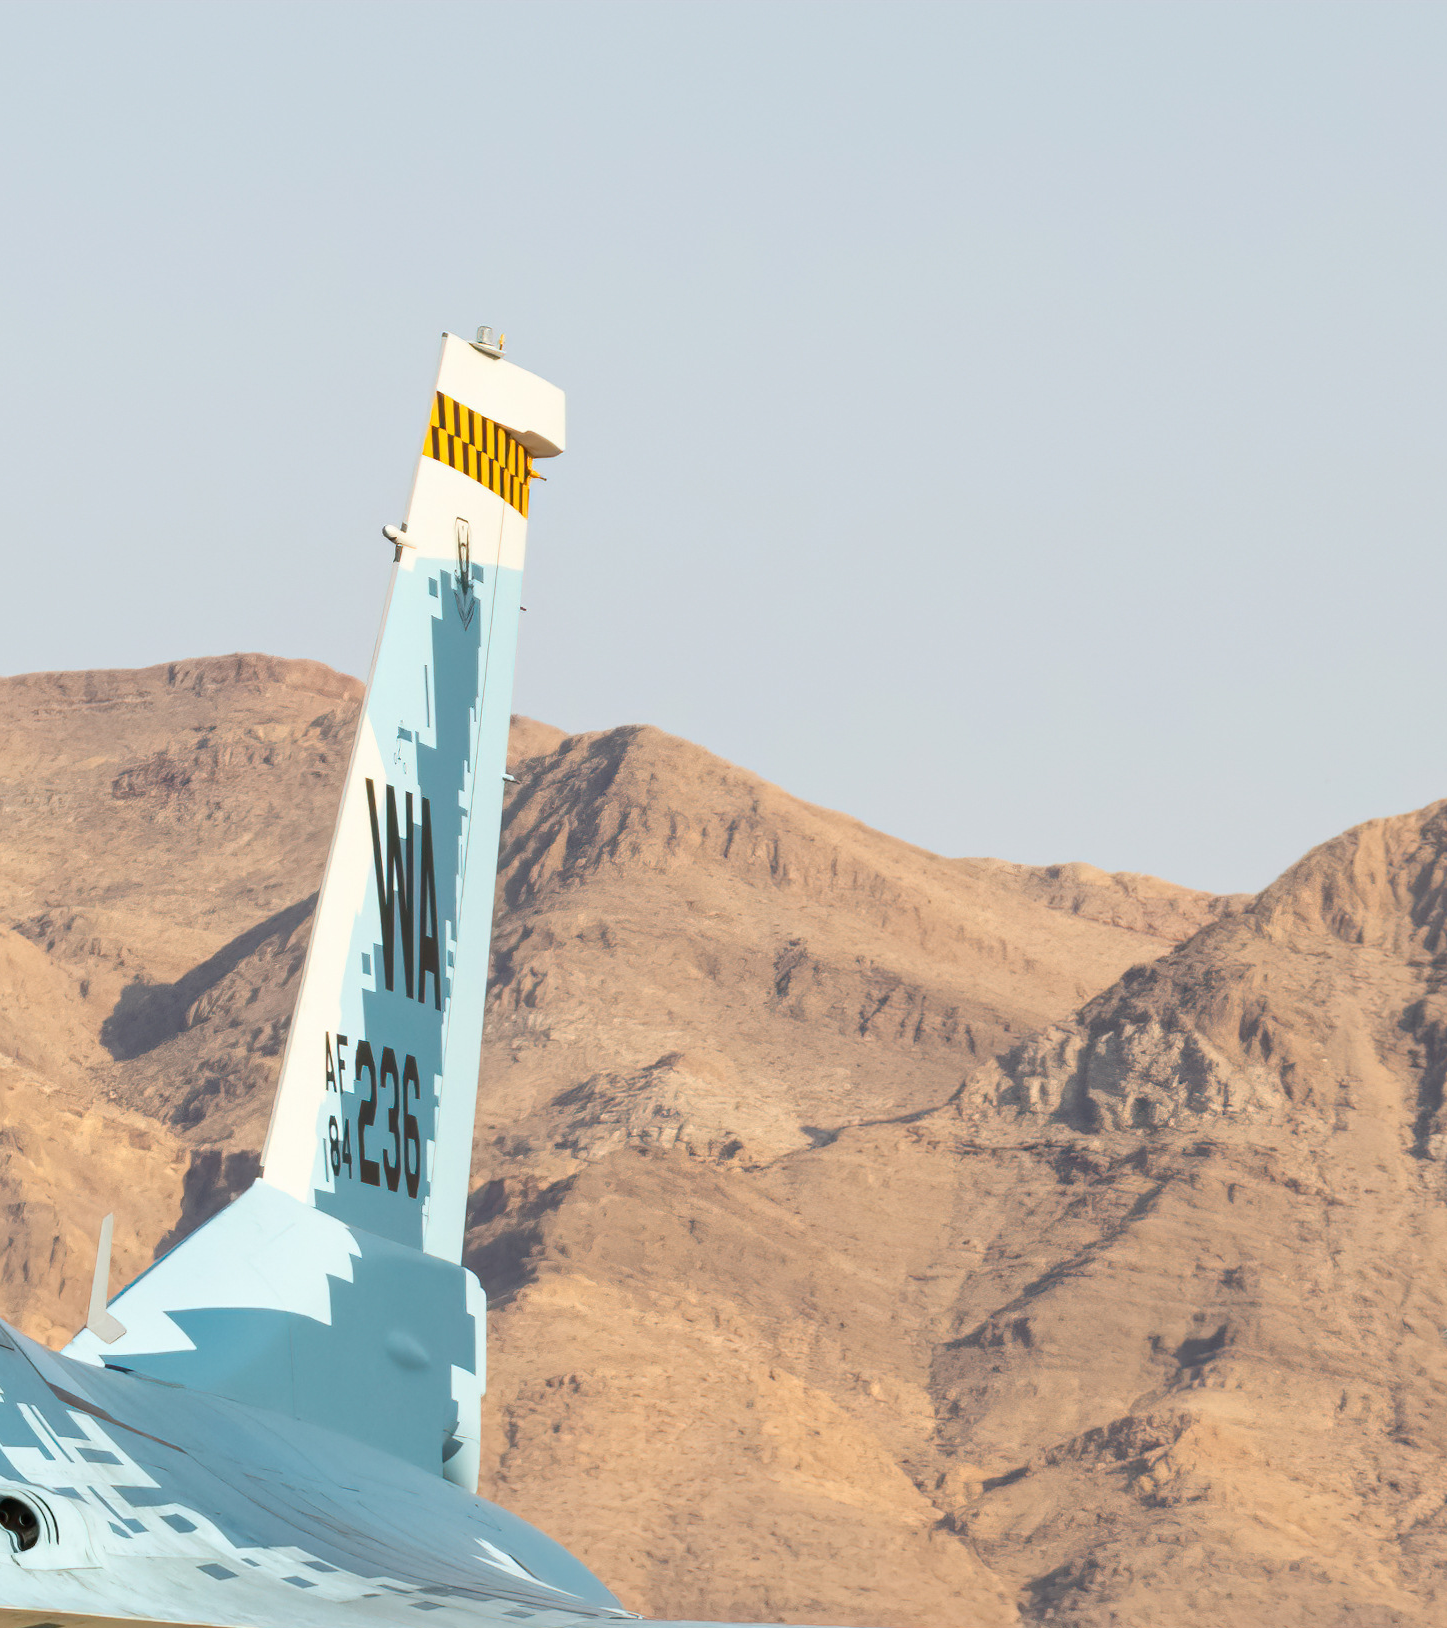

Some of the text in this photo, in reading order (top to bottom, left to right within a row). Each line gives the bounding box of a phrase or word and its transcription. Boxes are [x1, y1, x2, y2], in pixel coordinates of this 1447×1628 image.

[365, 778, 442, 1012] WA
[325, 1031, 349, 1094] AF
[355, 1039, 421, 1199] 236
